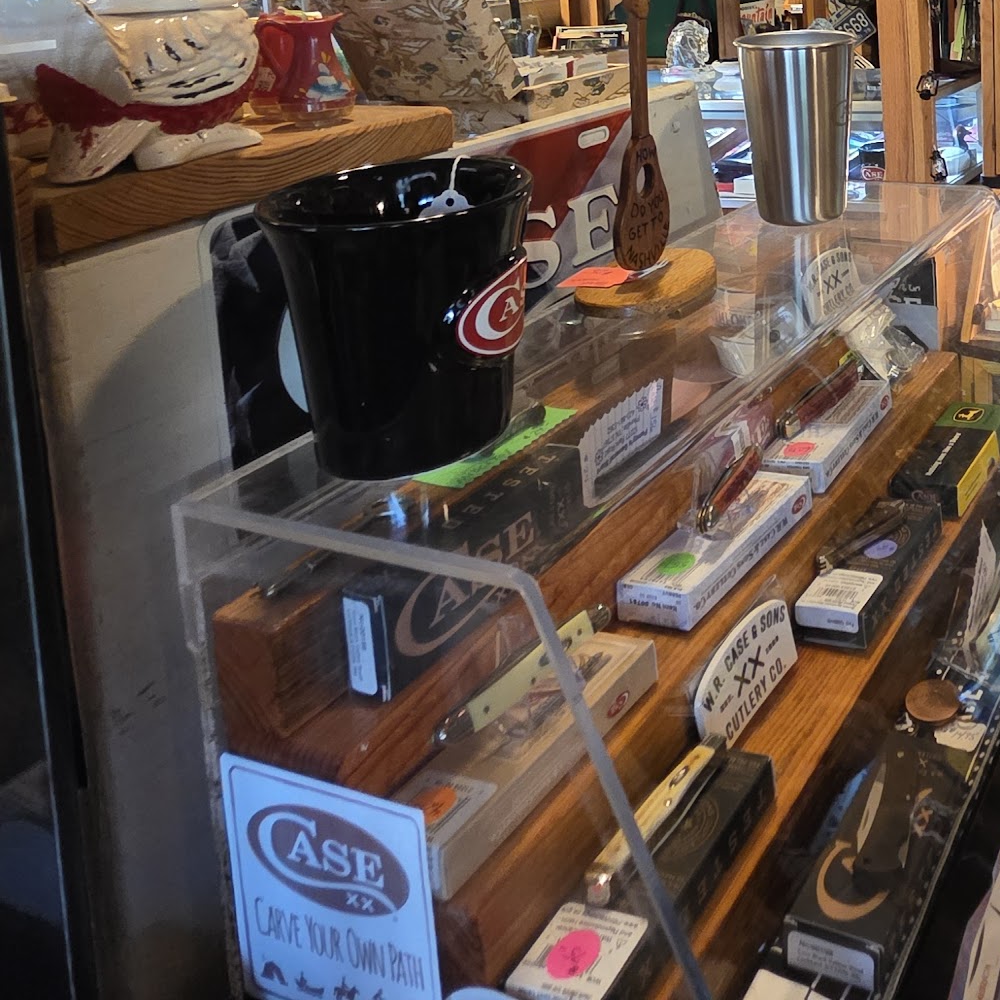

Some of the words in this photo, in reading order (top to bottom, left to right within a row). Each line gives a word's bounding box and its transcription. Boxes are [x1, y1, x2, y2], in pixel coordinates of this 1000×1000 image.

[628, 222, 649, 241] GET
[631, 202, 646, 219] DO
[471, 270, 526, 344] CA
[702, 676, 725, 714] W.R.
[724, 630, 750, 672] CASE
[752, 625, 759, 640] &
[760, 605, 786, 633] SONS
[725, 675, 767, 741] CUTLERY
[769, 657, 788, 684] CO.
[733, 645, 765, 699] XX
[257, 811, 396, 910] CASE
[254, 897, 303, 950] CARVE
[304, 912, 342, 958] YOUR
[346, 928, 385, 979] OWN
[389, 942, 426, 992] PATH
